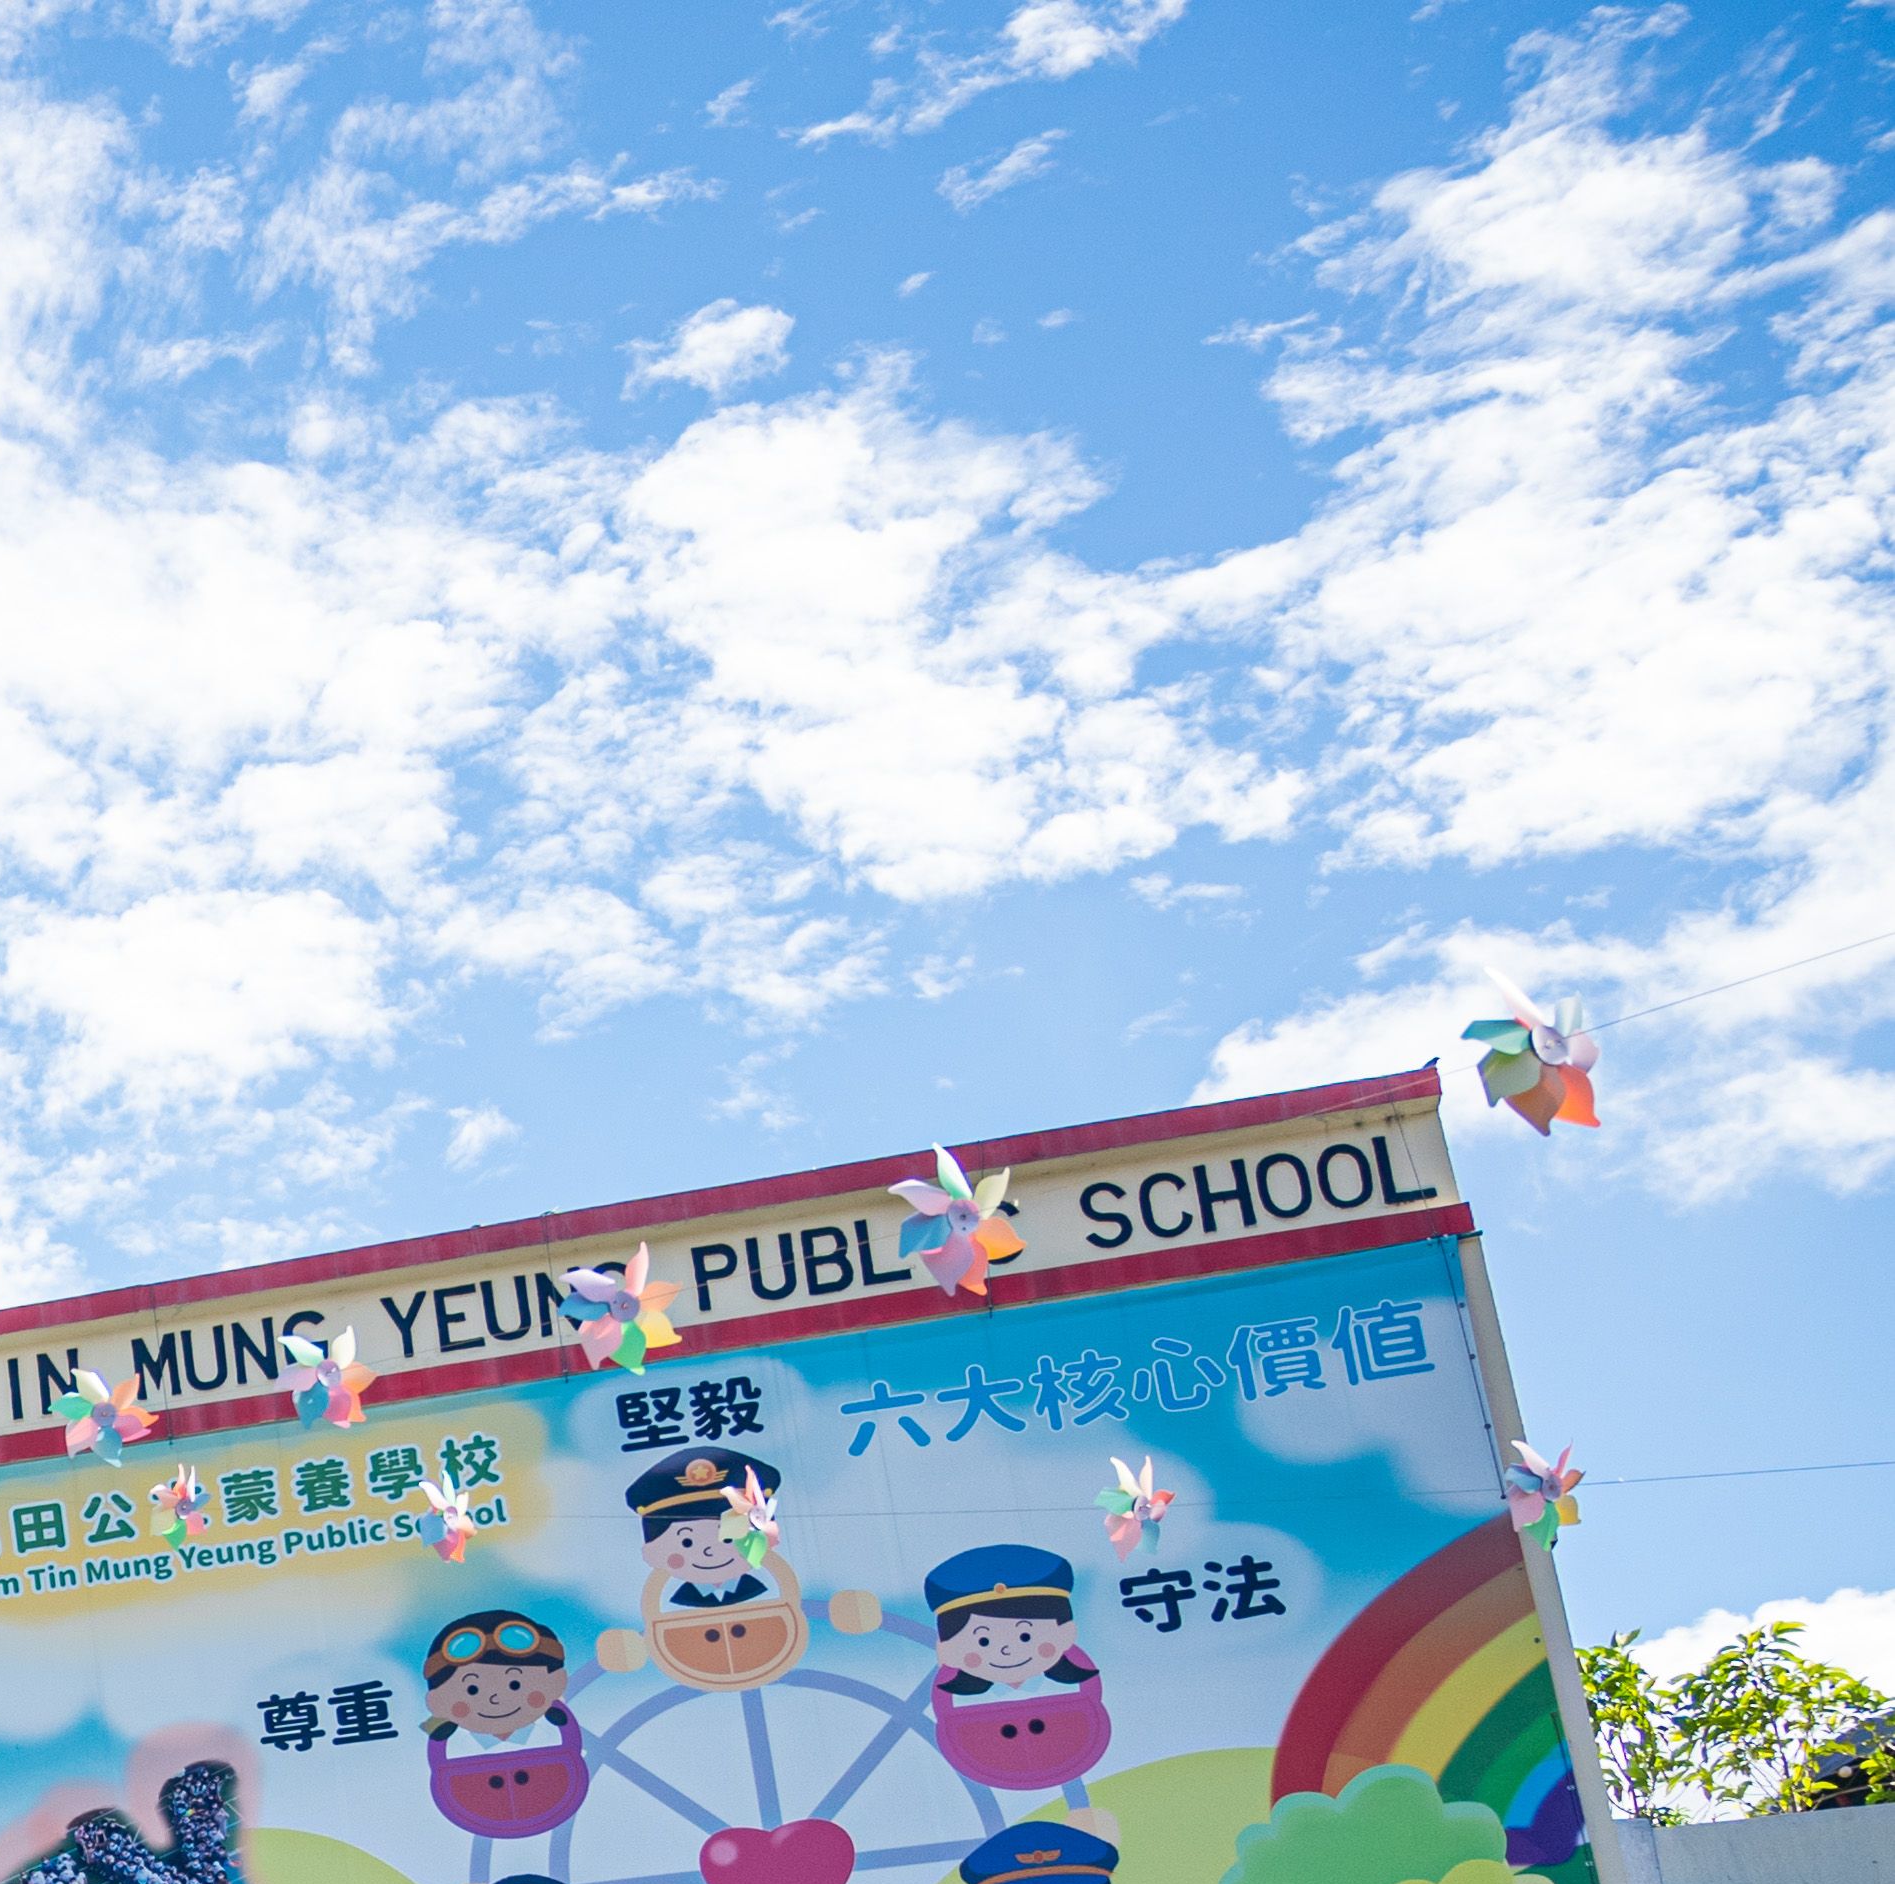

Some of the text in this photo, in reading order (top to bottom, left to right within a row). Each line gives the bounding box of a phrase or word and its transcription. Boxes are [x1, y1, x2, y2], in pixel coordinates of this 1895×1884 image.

[380, 1261, 627, 1359] YEUN
[690, 1200, 1025, 1312] PUBL
[1079, 1134, 1438, 1250] SCHOOL
[615, 1376, 765, 1453] 堅毅
[840, 1298, 1437, 1458] 六大核心價值
[28, 1564, 77, 1592] Tin
[86, 1553, 171, 1584] Mung
[178, 1537, 277, 1570] Yeung
[283, 1517, 385, 1555] Public
[393, 1497, 507, 1538] Sol
[1120, 1555, 1287, 1634] 守法
[256, 1679, 400, 1755] 尊重
